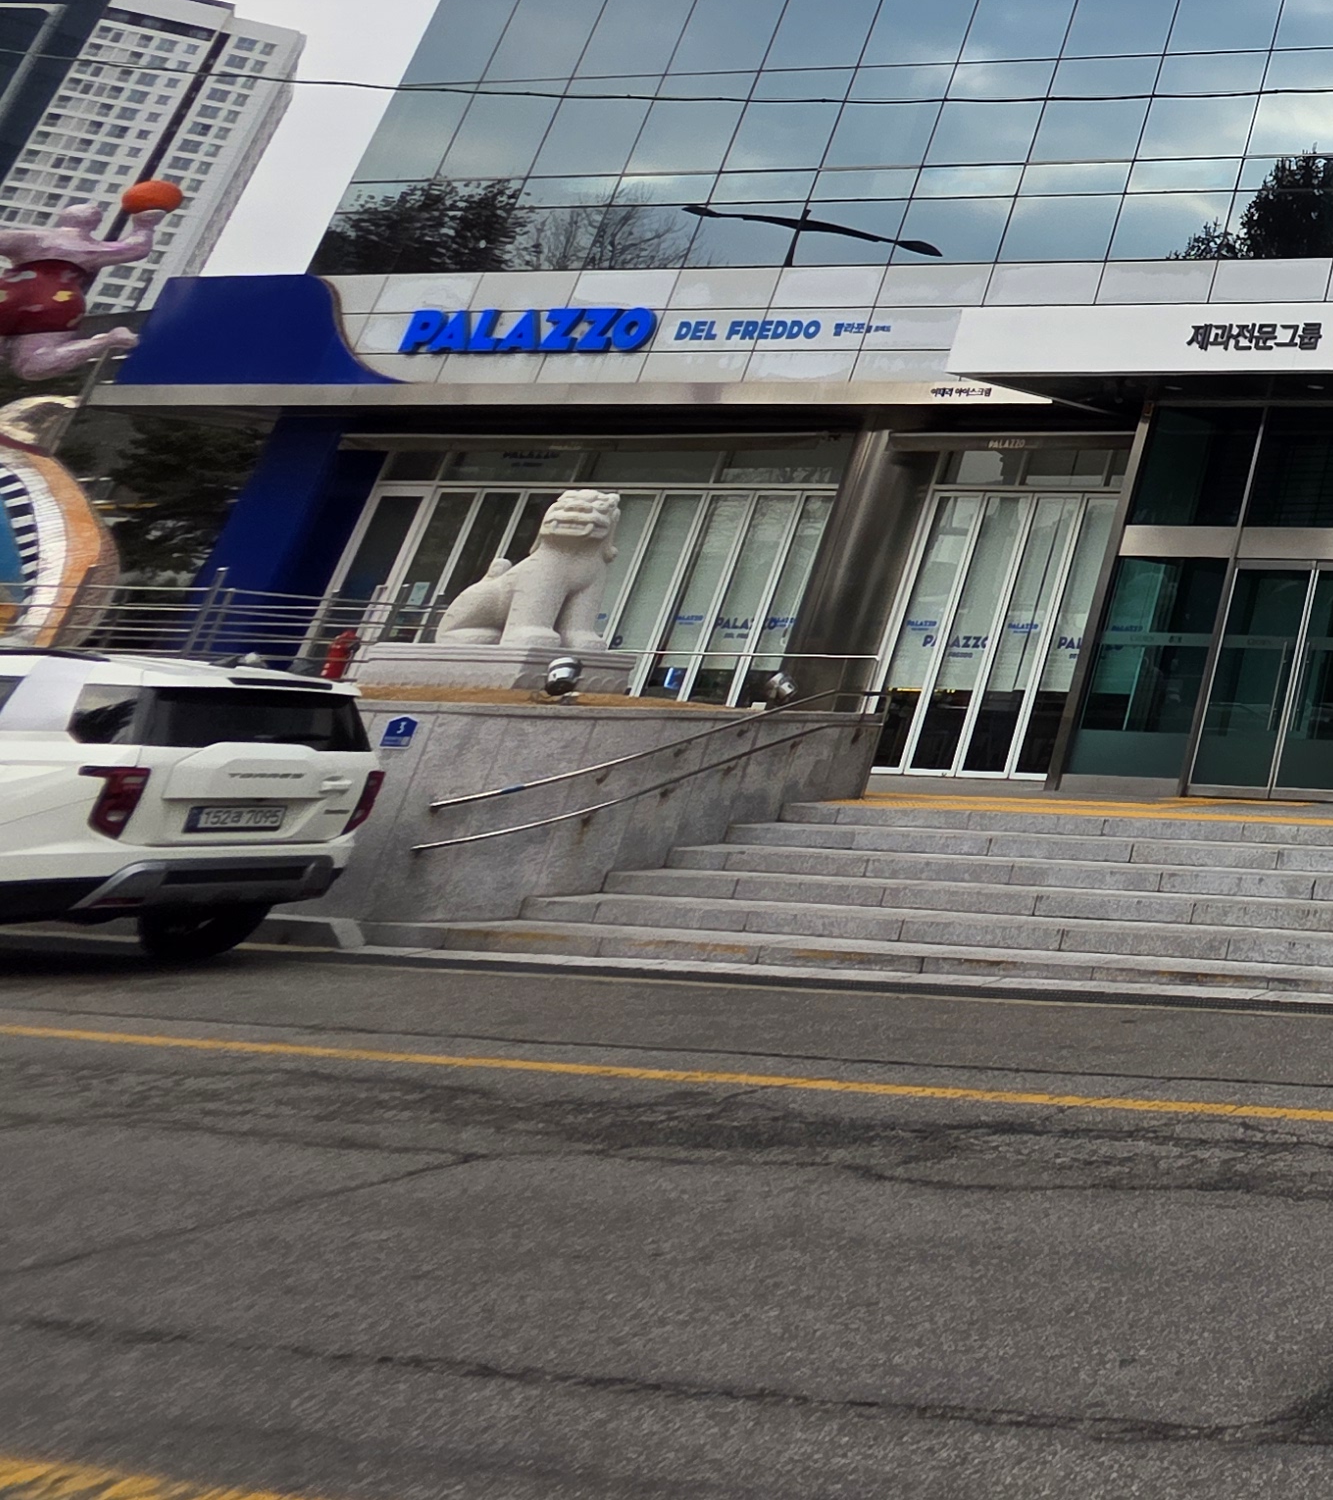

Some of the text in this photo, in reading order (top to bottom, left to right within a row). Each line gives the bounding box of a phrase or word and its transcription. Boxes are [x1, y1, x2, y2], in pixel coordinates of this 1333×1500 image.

[398, 307, 821, 355] PALAZZO DEL FREDDO
[1185, 322, 1323, 352] 제과전문그룹
[714, 616, 777, 631] PALAO
[245, 808, 283, 826] 7095
